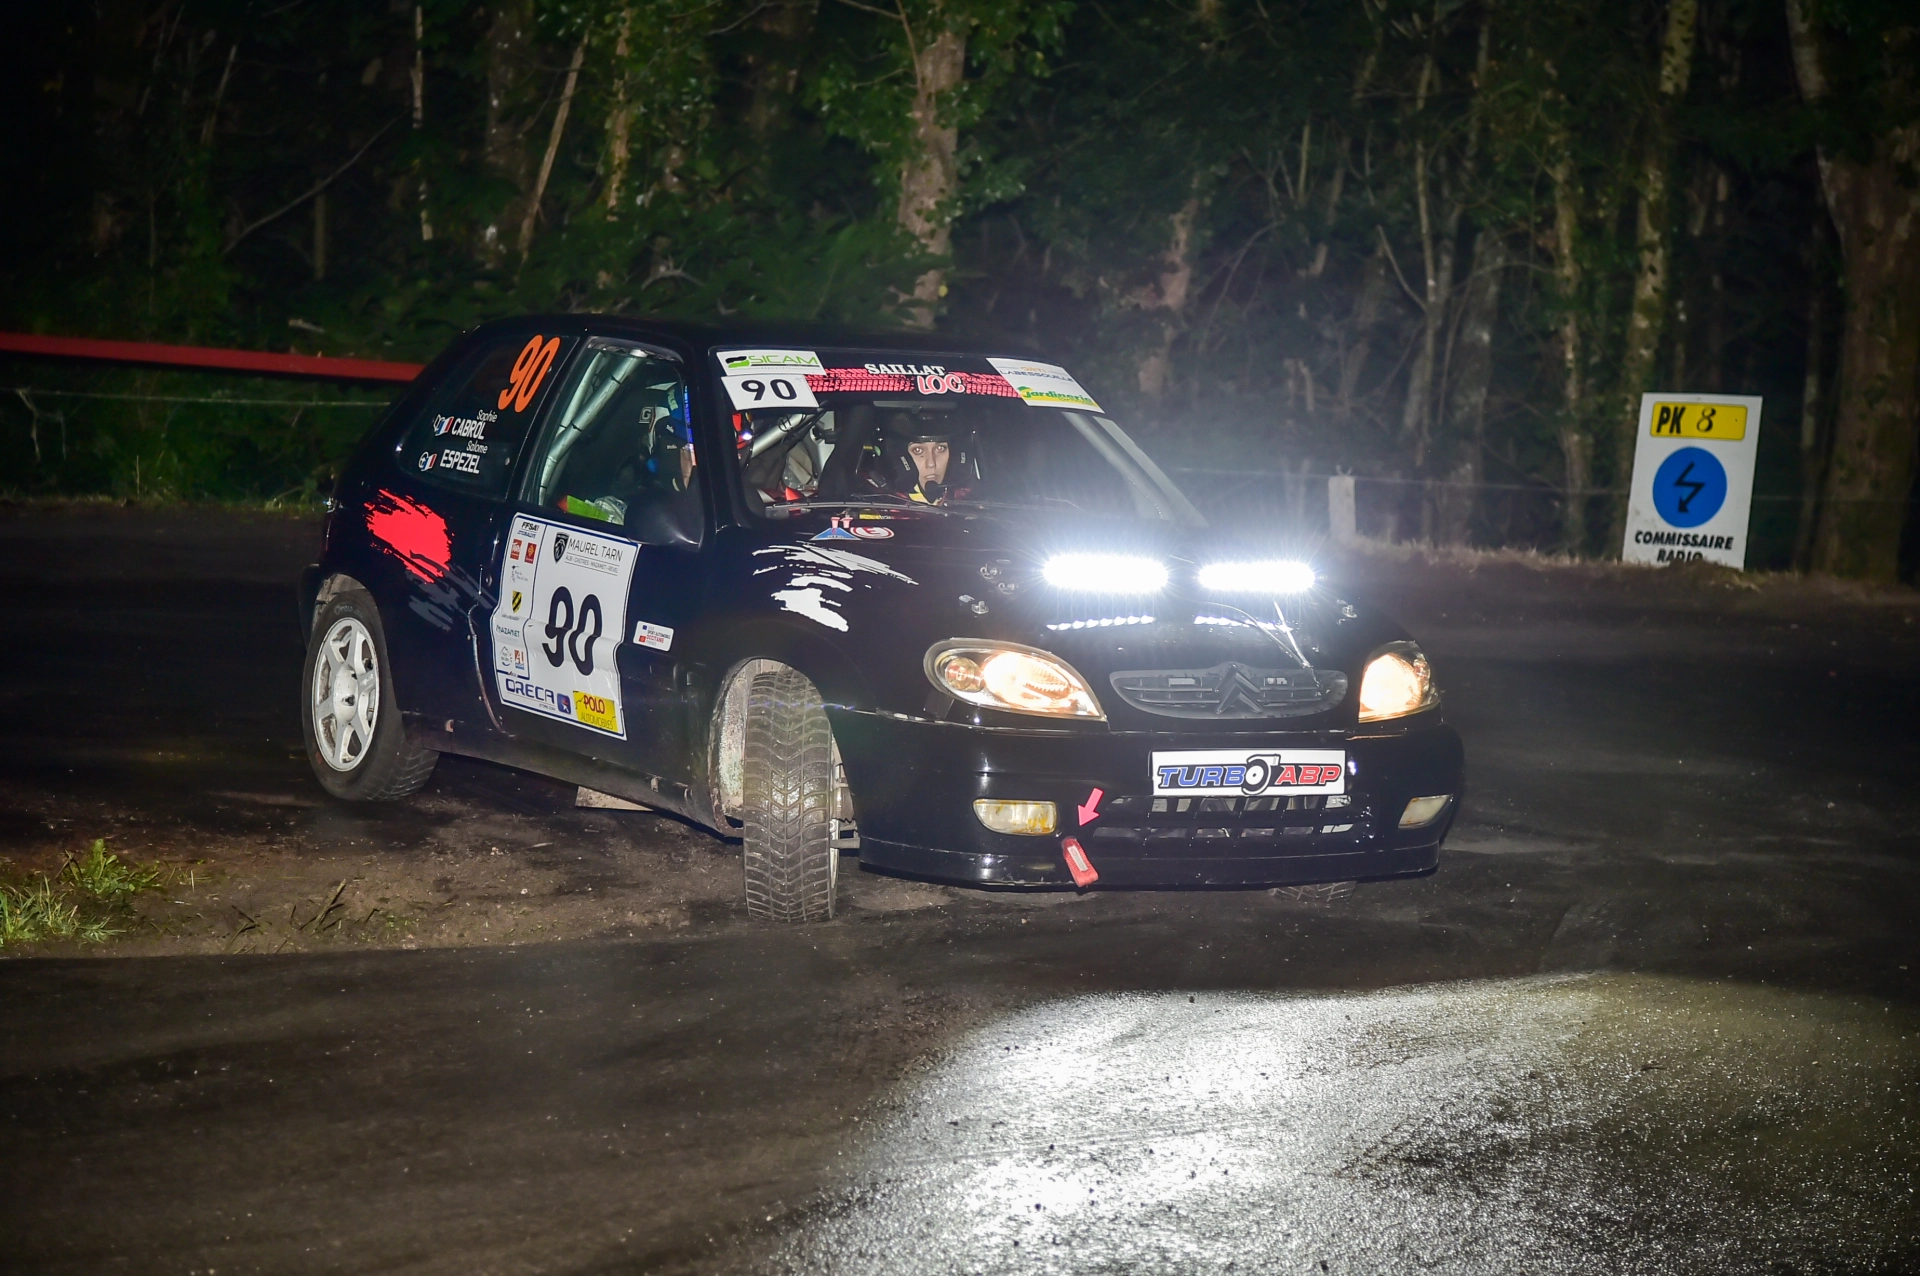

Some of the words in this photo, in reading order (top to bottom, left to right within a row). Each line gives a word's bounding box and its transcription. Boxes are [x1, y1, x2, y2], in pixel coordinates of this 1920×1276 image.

[749, 355, 819, 365] SICAM
[864, 363, 946, 376] SAILLAT
[498, 334, 561, 413] 90
[741, 378, 798, 401] 90
[917, 374, 966, 395] LOC
[476, 409, 498, 423] Sophie
[1656, 406, 1686, 434] PK
[1696, 407, 1716, 432] 8
[451, 418, 485, 440] CABROL
[440, 449, 480, 474] ESPEZEL
[521, 521, 538, 532] FFSA
[1634, 530, 1734, 549] COMMISSAIRE
[568, 539, 598, 556] MAUREL
[601, 546, 623, 562] TARN
[496, 624, 520, 637] MAZAMET
[542, 586, 603, 676] 90
[506, 678, 555, 704] ORECA
[583, 694, 606, 715] POLO
[581, 711, 614, 730] AUTOMOBILES
[1158, 757, 1272, 794] TURBO
[1275, 765, 1341, 785] ABP
